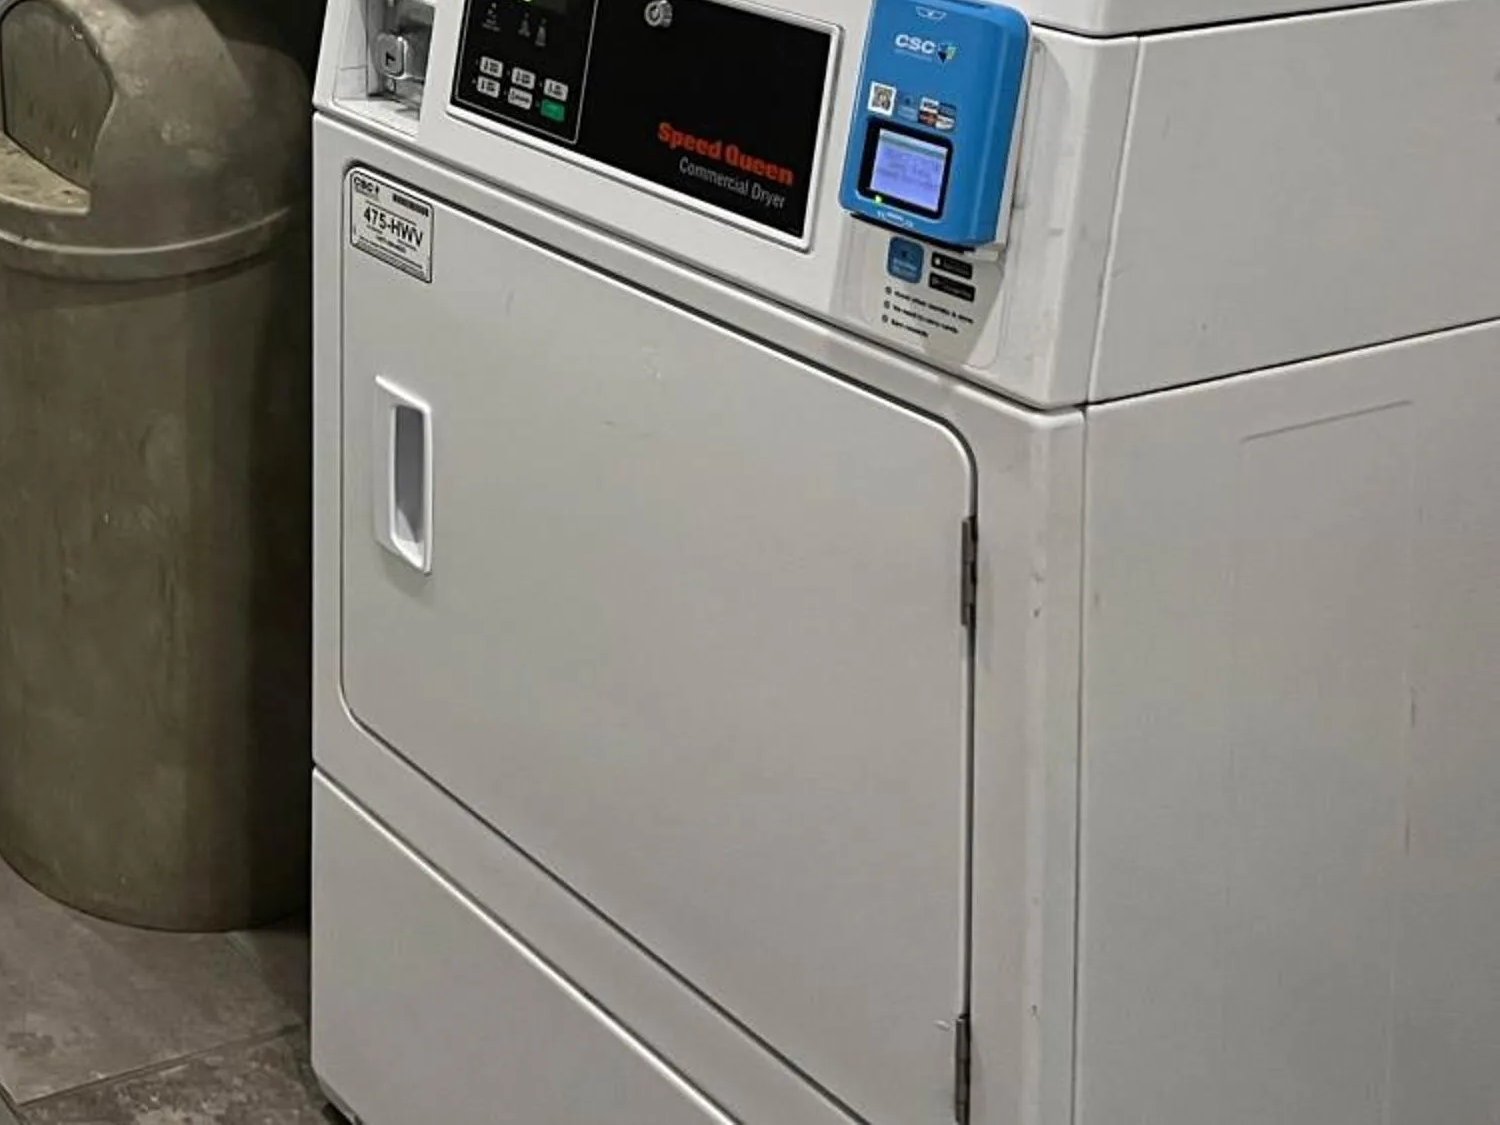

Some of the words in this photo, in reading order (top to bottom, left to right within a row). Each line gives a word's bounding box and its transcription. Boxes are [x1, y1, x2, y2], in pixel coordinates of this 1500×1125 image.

[895, 33, 935, 54] CSC
[658, 122, 722, 161] Speed
[724, 143, 794, 187] Queen
[678, 155, 749, 196] Commercial
[751, 181, 786, 209] Dryer
[364, 207, 423, 247] 475-HWV
